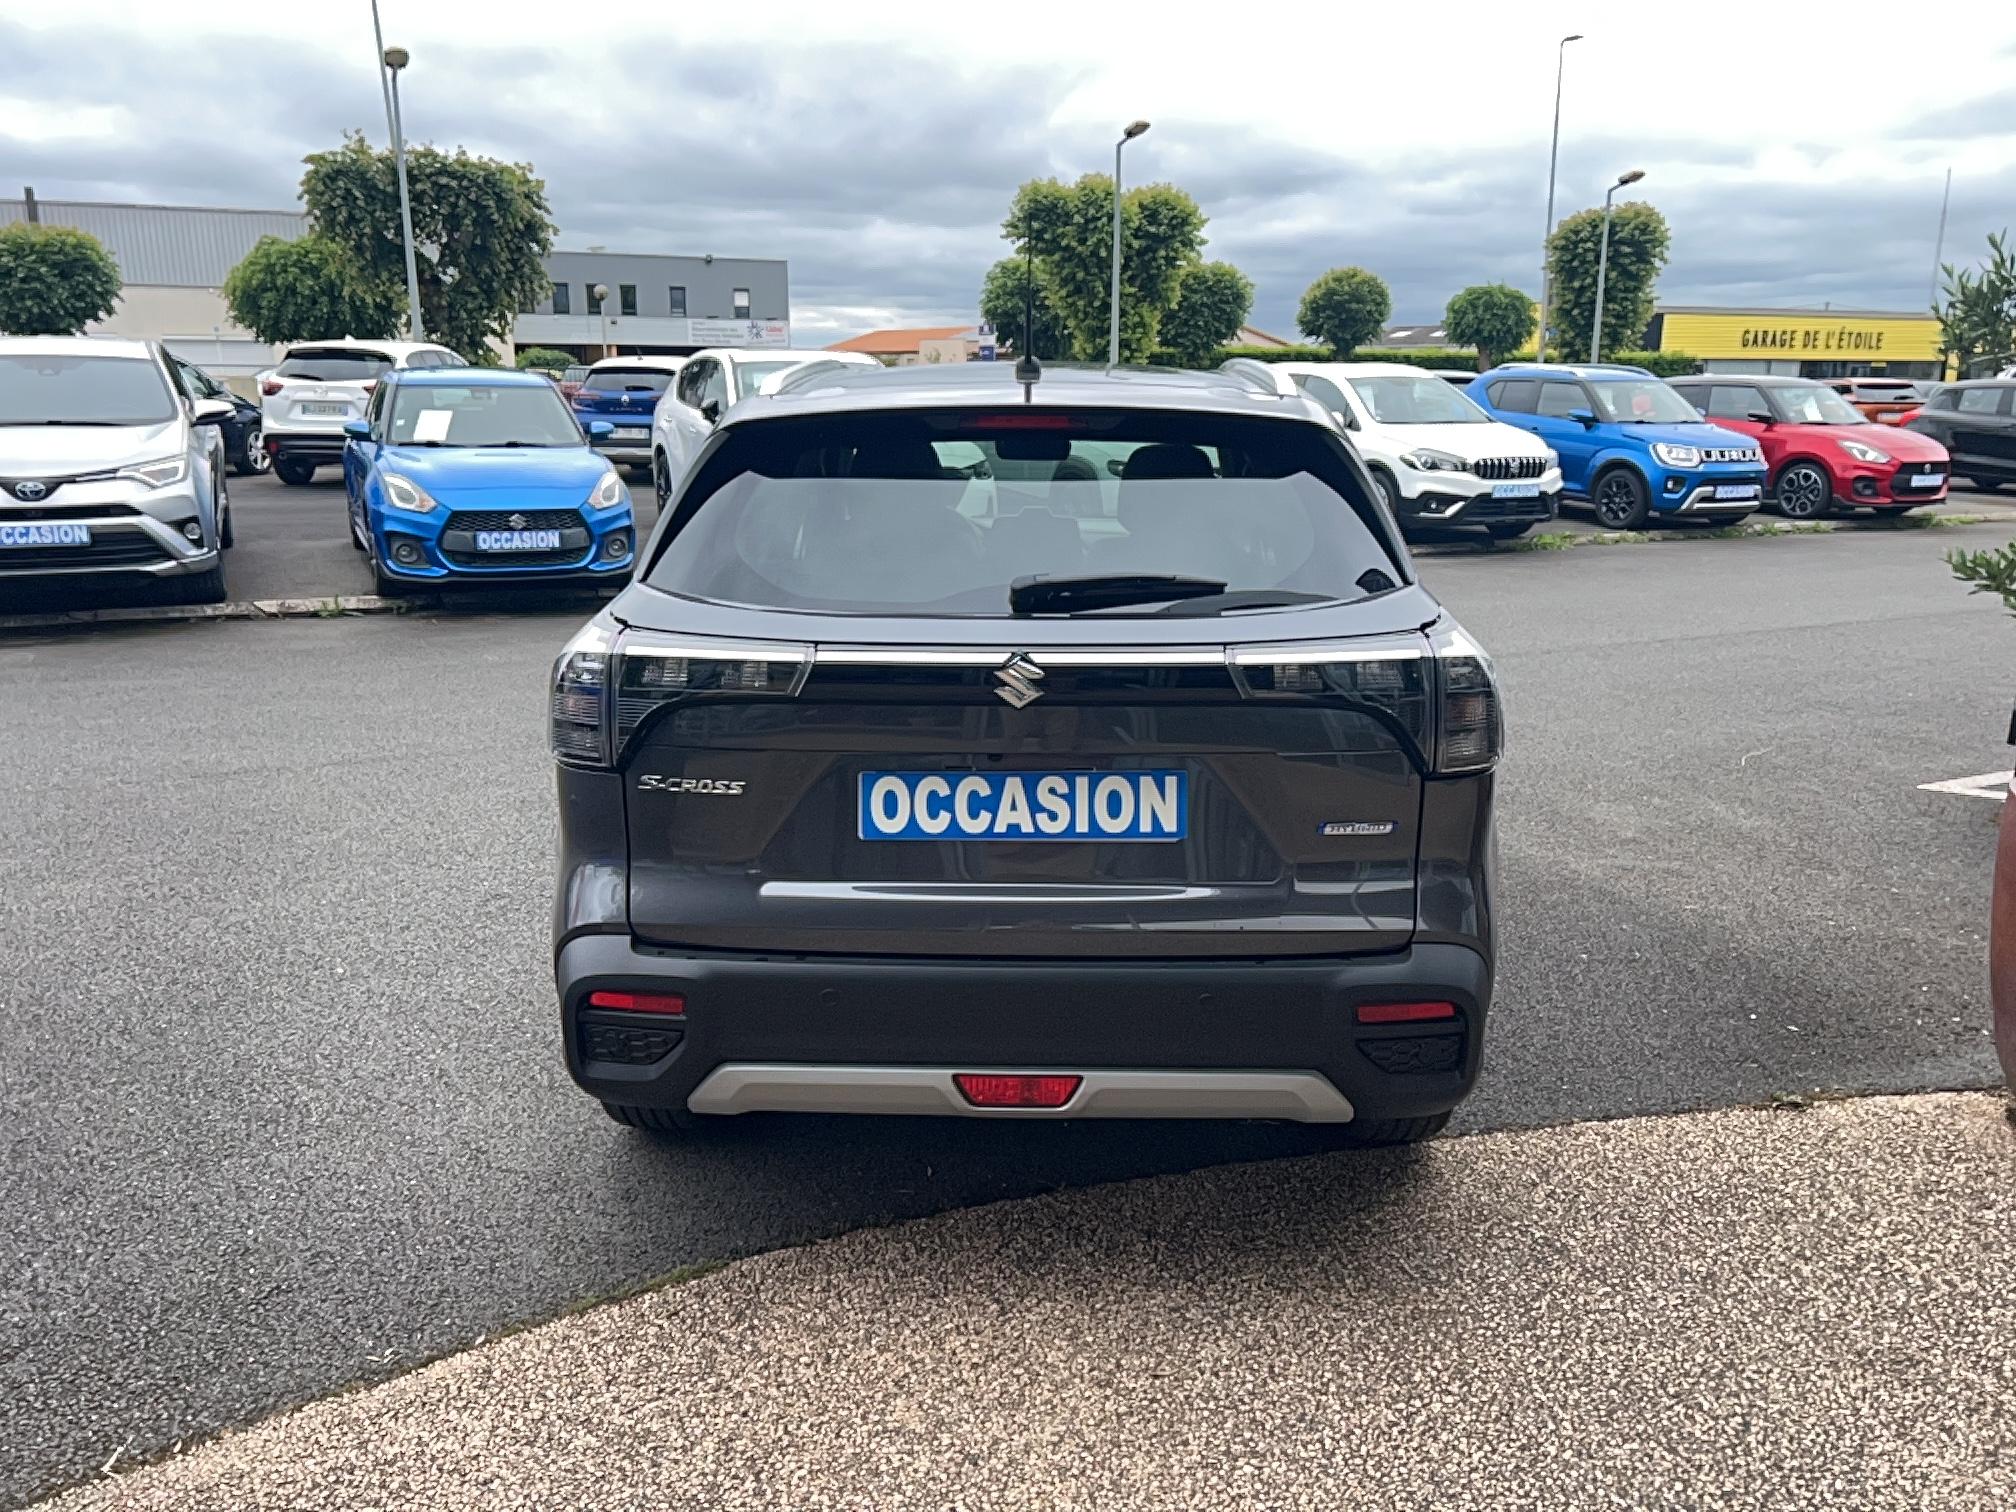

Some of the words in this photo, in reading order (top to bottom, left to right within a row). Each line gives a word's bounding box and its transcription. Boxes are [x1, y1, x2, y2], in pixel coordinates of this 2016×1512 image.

[1742, 329, 1797, 349] GARAGE
[1802, 330, 1820, 349] DE
[1825, 326, 1884, 350] L'ÉTOILE
[0, 525, 89, 544] CCASION
[479, 531, 560, 549] OCCASION
[638, 775, 746, 795] S-CROSS
[870, 775, 1178, 834] OCCASION
